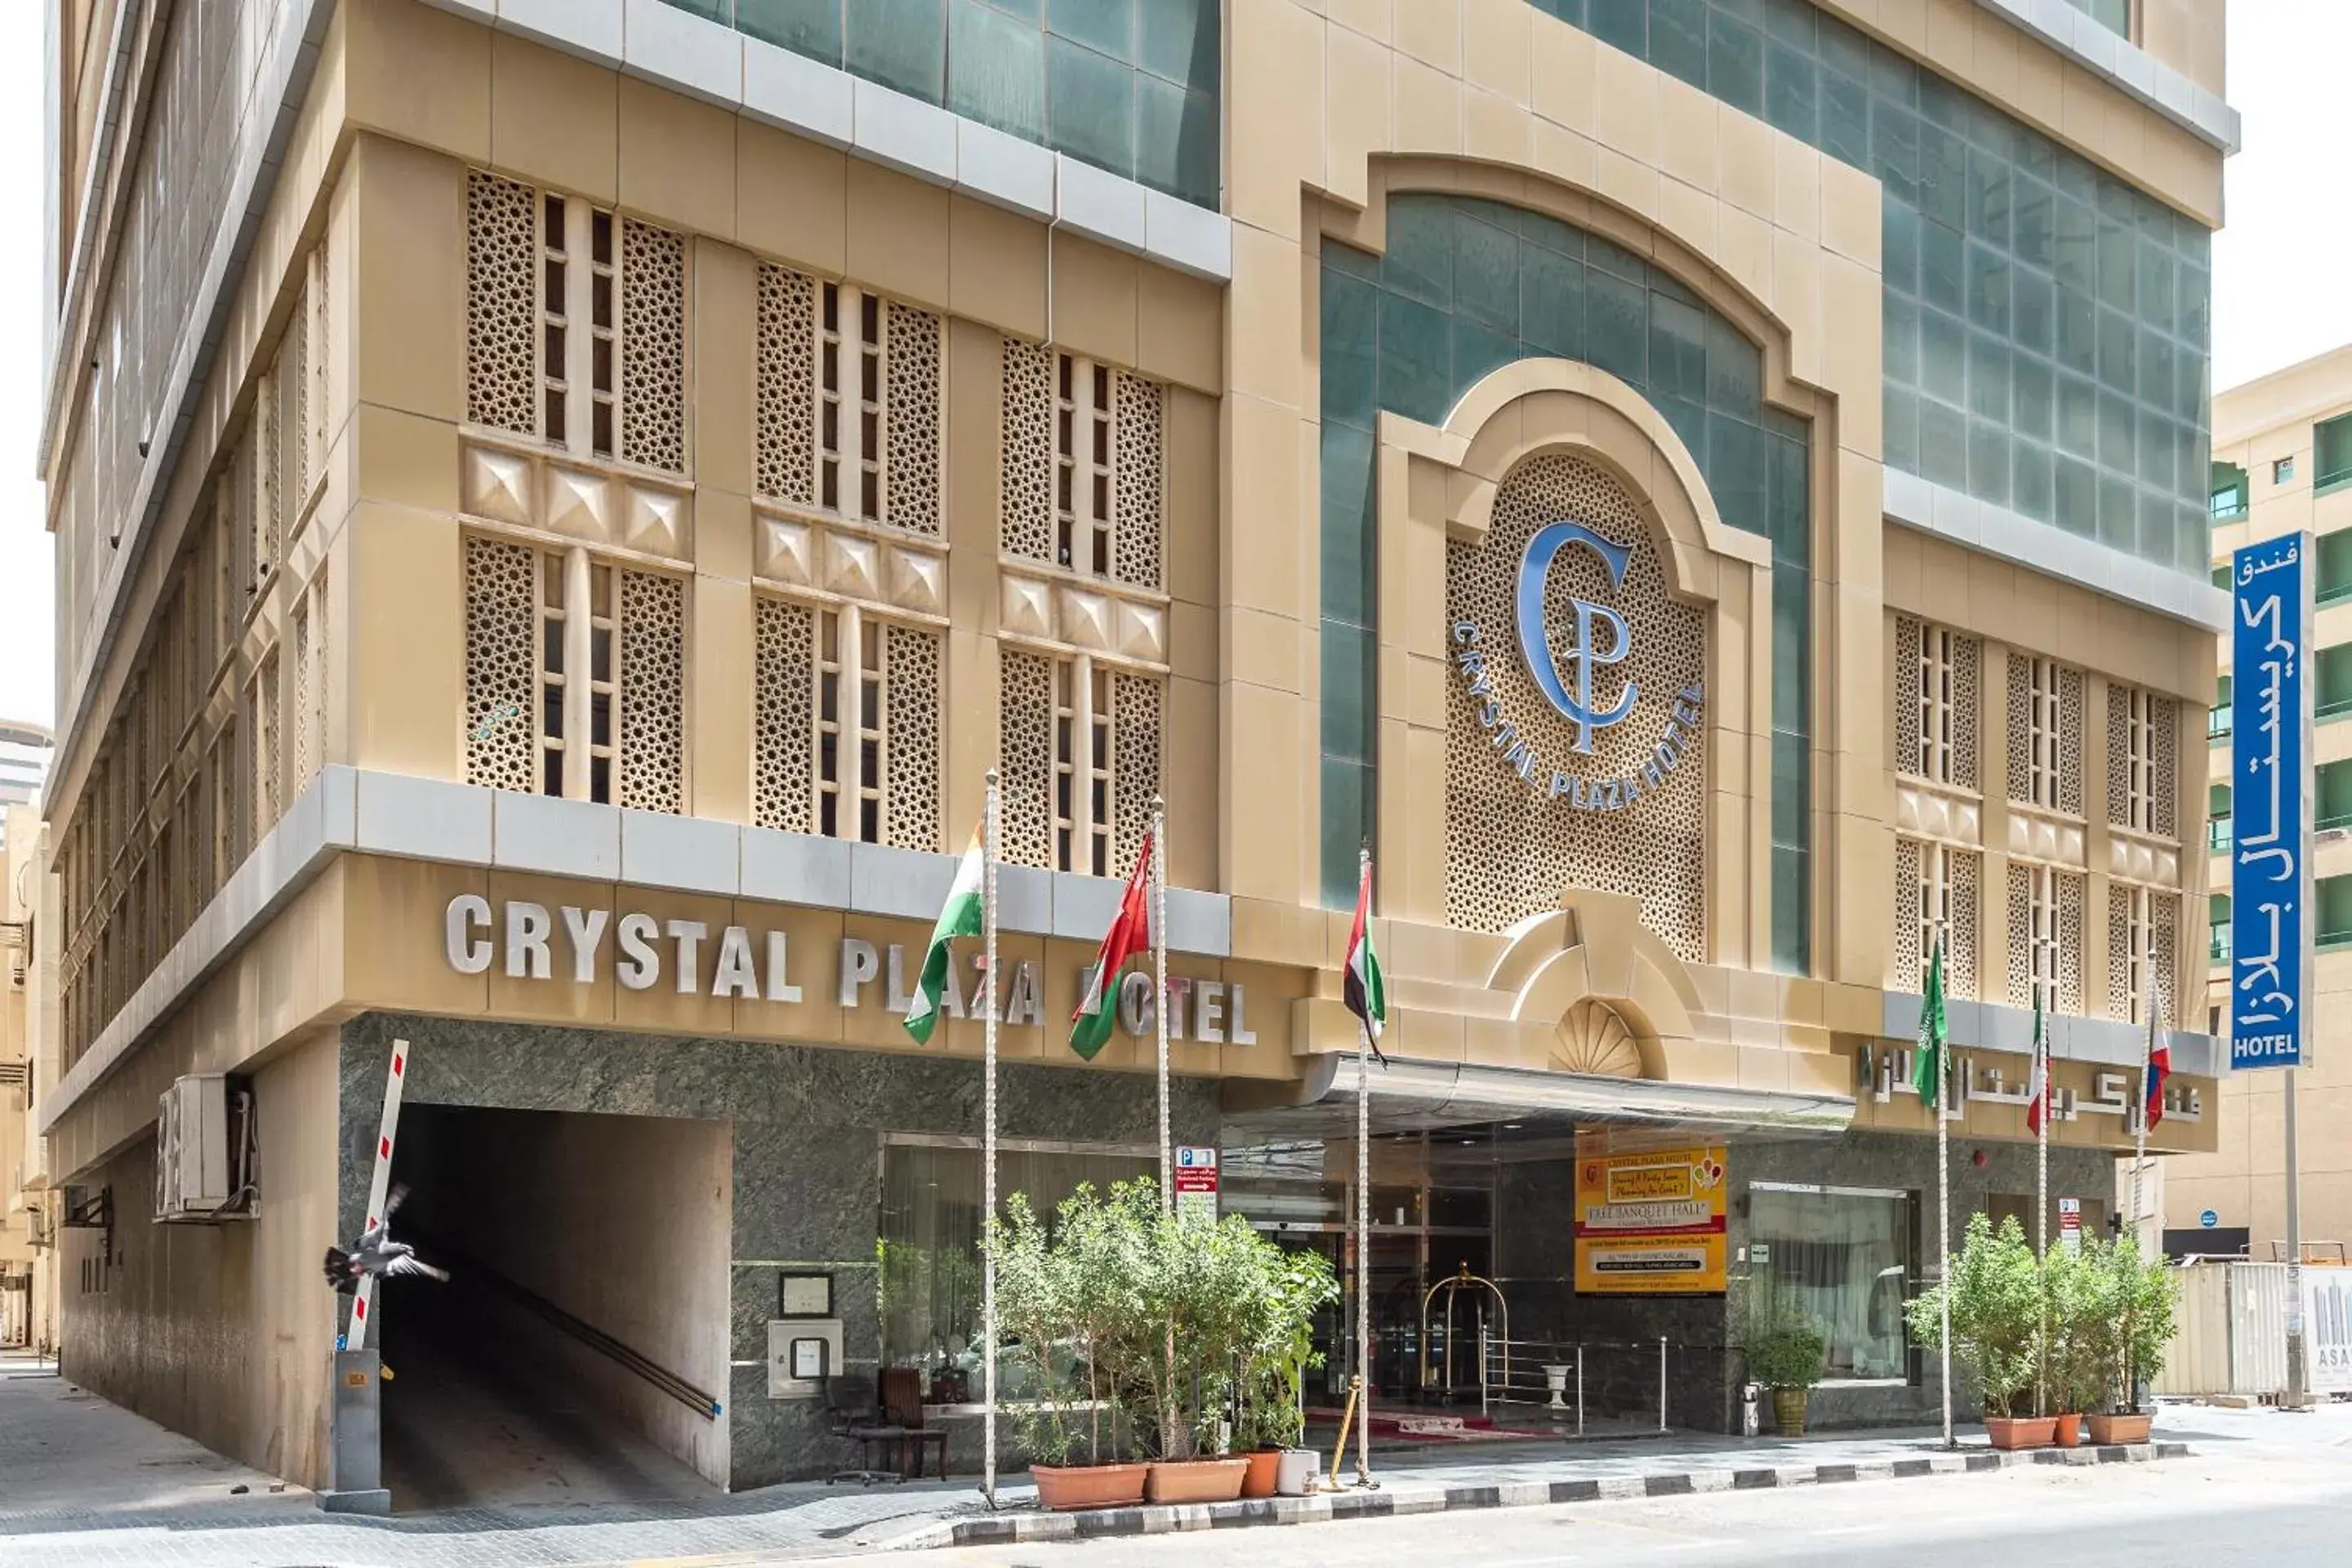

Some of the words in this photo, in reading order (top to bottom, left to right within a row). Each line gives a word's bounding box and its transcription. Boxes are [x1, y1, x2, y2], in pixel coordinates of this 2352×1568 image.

[2236, 541, 2299, 586] فندق
[1453, 619, 1539, 789] CRYSTAL
[1548, 770, 1642, 811] PLAZA
[1639, 682, 1704, 791] HOTEL
[2238, 594, 2295, 882] كريستال
[444, 893, 803, 1004] CRYSTAL
[1081, 966, 1258, 1046] OTEL
[2237, 901, 2295, 1026] بلازا
[2234, 1034, 2297, 1058] HOTEL
[2319, 1348, 2352, 1366] ASA
